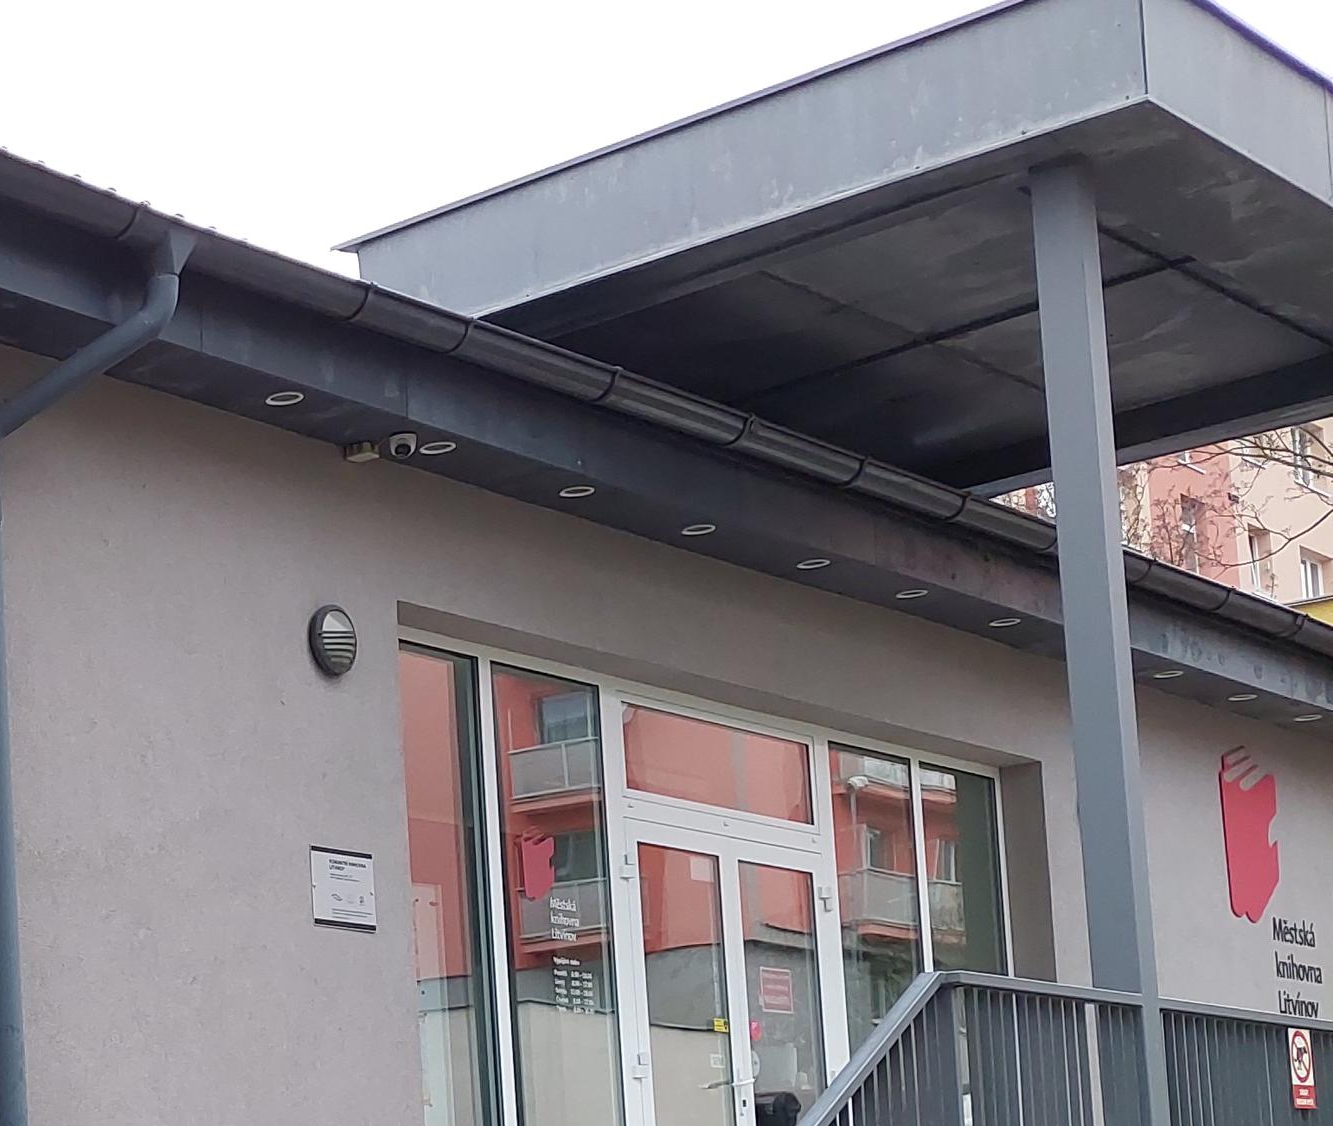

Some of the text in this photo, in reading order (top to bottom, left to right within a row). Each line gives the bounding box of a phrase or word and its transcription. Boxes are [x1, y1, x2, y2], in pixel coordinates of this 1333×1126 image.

[1272, 916, 1316, 947] Městská
[1274, 950, 1323, 985] knihovna
[1277, 990, 1319, 1019] Litvínov
